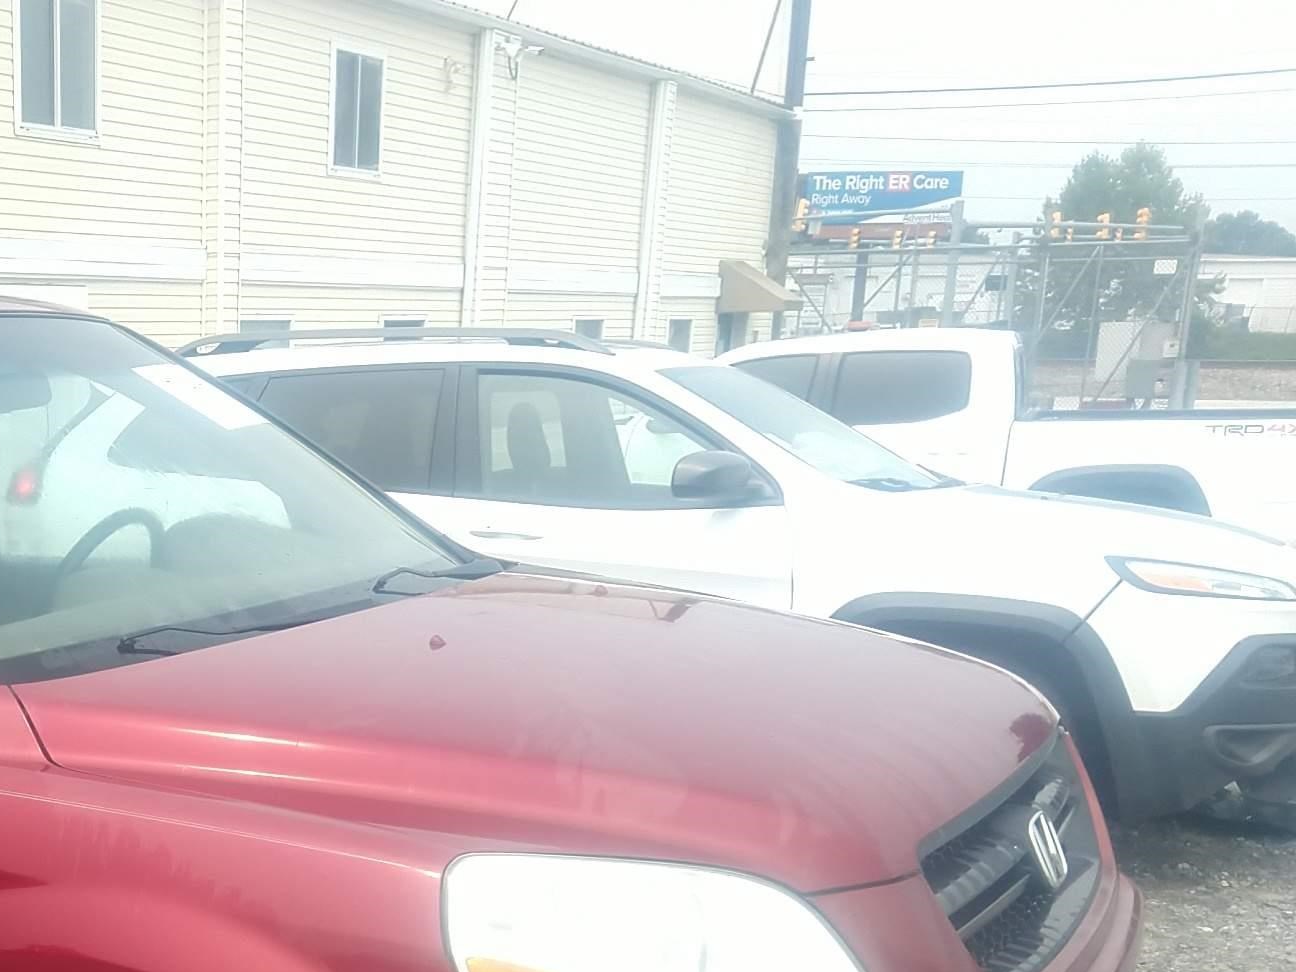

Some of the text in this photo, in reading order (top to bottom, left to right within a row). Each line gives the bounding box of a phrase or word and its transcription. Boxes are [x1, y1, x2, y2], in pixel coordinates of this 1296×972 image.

[813, 174, 950, 193] The Right ER Care
[811, 193, 872, 207] Right Away
